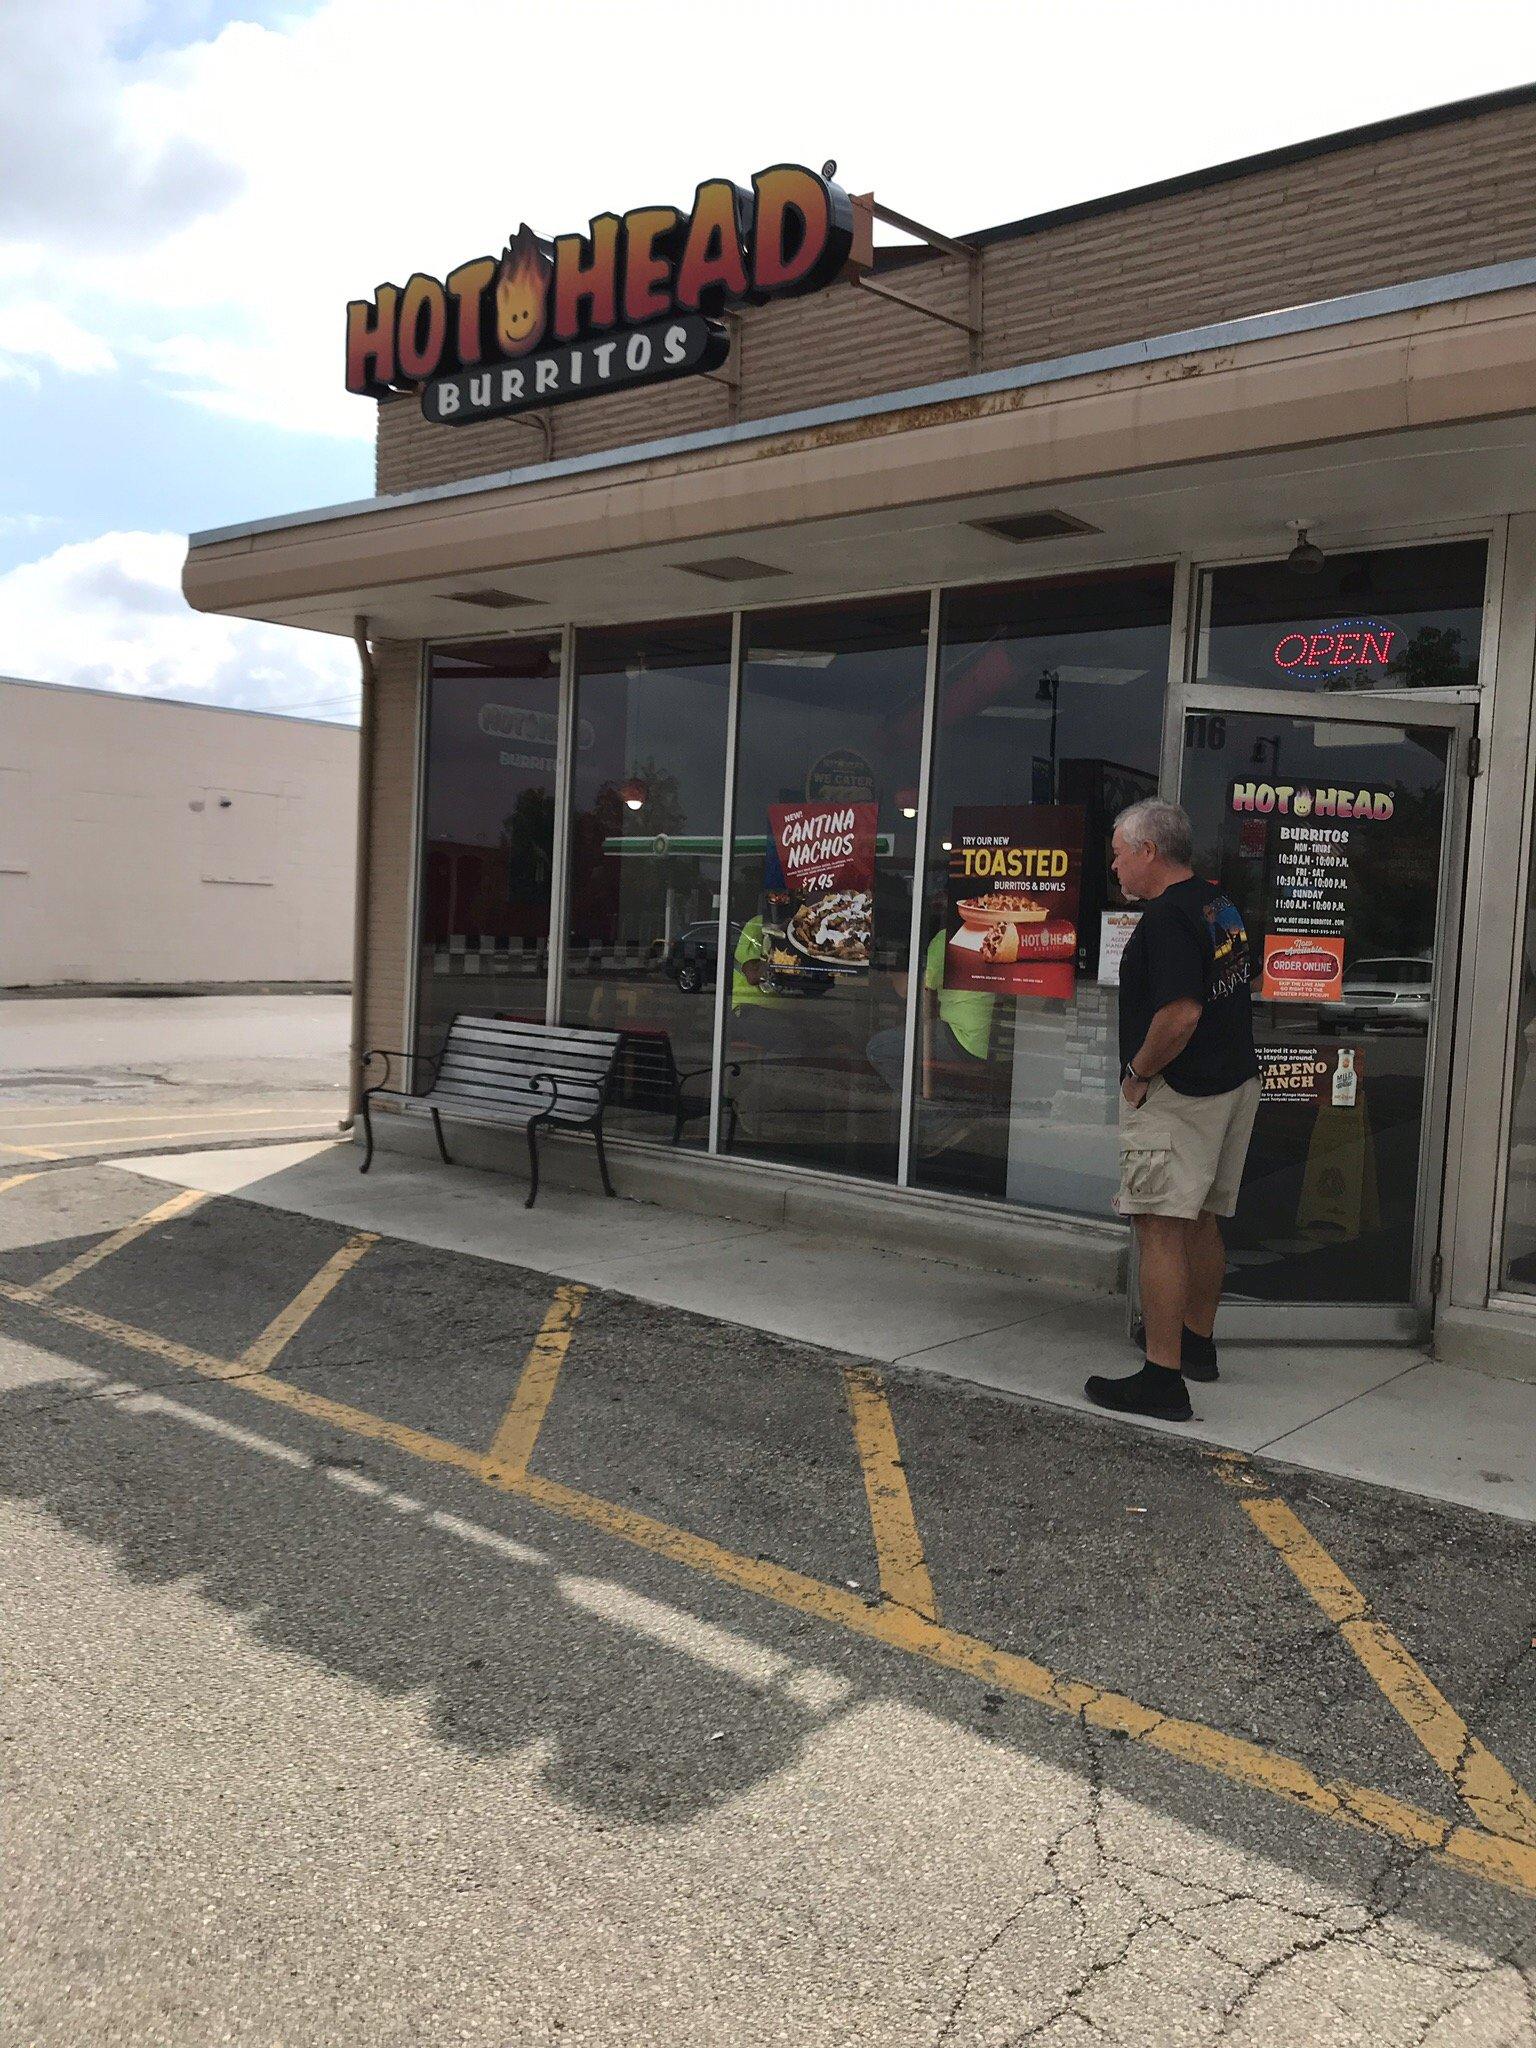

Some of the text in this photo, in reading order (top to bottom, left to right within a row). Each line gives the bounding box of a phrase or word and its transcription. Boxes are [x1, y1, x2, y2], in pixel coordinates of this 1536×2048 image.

[346, 162, 835, 394] HOT HEAD
[437, 325, 690, 418] BURRITOS
[1274, 631, 1396, 667] OPEN
[1233, 782, 1394, 820] HOT HEAD
[782, 808, 855, 847] CANTINA
[962, 837, 1010, 846] TRY OUR NEW
[1280, 827, 1349, 843] BURRITOS
[787, 833, 855, 869] NACHOS
[1294, 843, 1308, 852] MON
[1312, 844, 1331, 854] THURS
[962, 849, 1069, 877] TOASTED
[1278, 854, 1297, 864] 10:30
[1316, 856, 1335, 867] 10:00
[1296, 868, 1307, 876] FRI
[1312, 868, 1325, 877] SAT
[803, 873, 835, 893] $7.95
[994, 881, 1066, 892] BURRITOS & BOWLS
[1276, 875, 1296, 887] 10:30
[1314, 877, 1334, 888] 10:00
[1292, 889, 1324, 899] SUNDAY
[1275, 899, 1295, 909] 11:00
[1313, 901, 1332, 911] 10:00
[1021, 934, 1040, 947] HOT
[1273, 961, 1332, 972] ORDER ONLINE
[1261, 1061, 1328, 1076] APENO
[1262, 1076, 1314, 1090] ANCH
